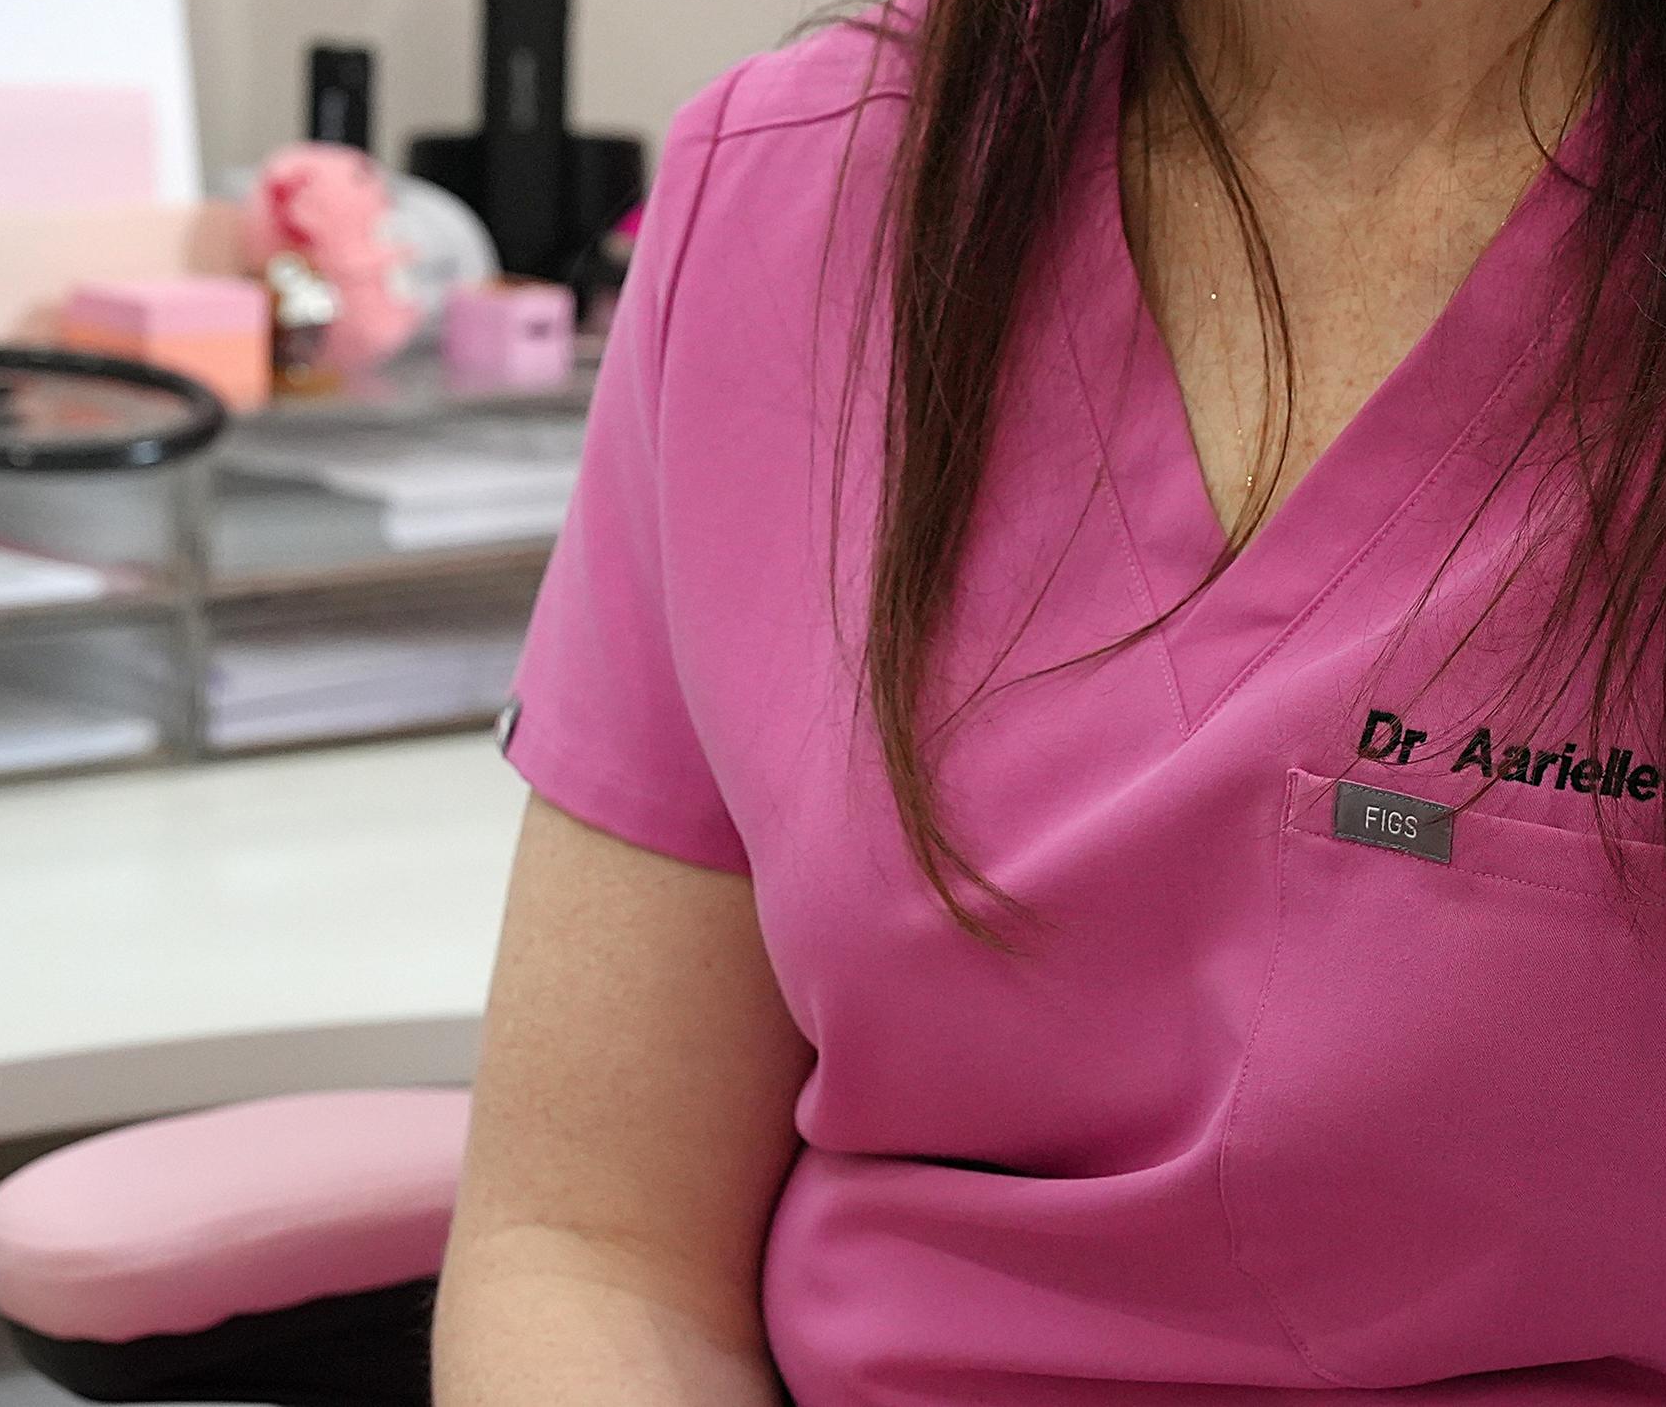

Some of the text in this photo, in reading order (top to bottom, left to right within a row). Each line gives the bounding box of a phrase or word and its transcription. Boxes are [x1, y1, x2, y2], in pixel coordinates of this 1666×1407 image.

[1356, 709, 1427, 765] Dr
[1450, 726, 1661, 802] Aarielle
[1364, 806, 1418, 839] FIGS
